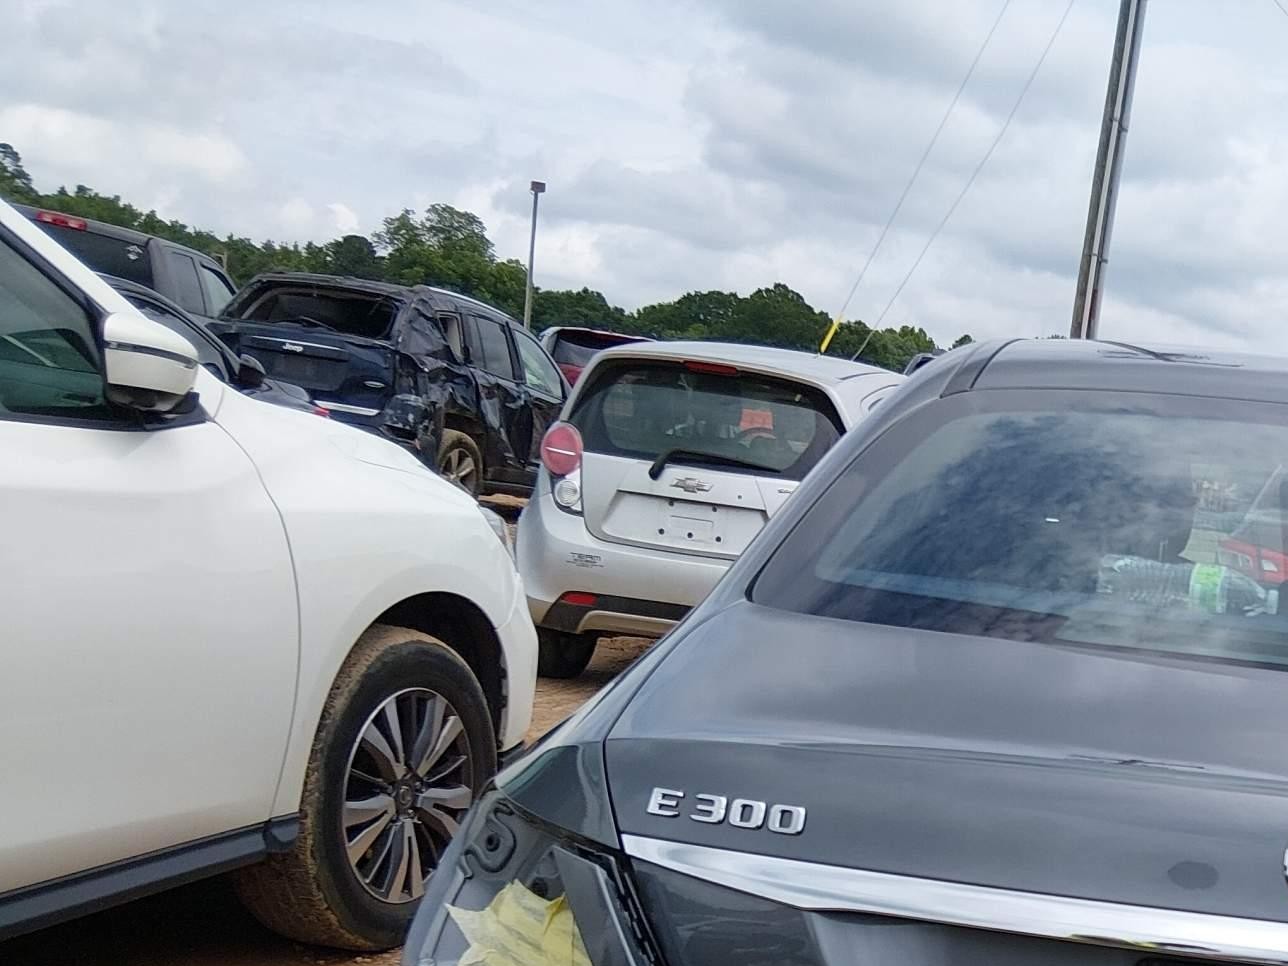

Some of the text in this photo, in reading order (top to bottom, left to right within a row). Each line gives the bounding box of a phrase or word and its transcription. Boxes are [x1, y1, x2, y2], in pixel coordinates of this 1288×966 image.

[282, 343, 304, 352] Jeep
[647, 787, 807, 835] E 300
